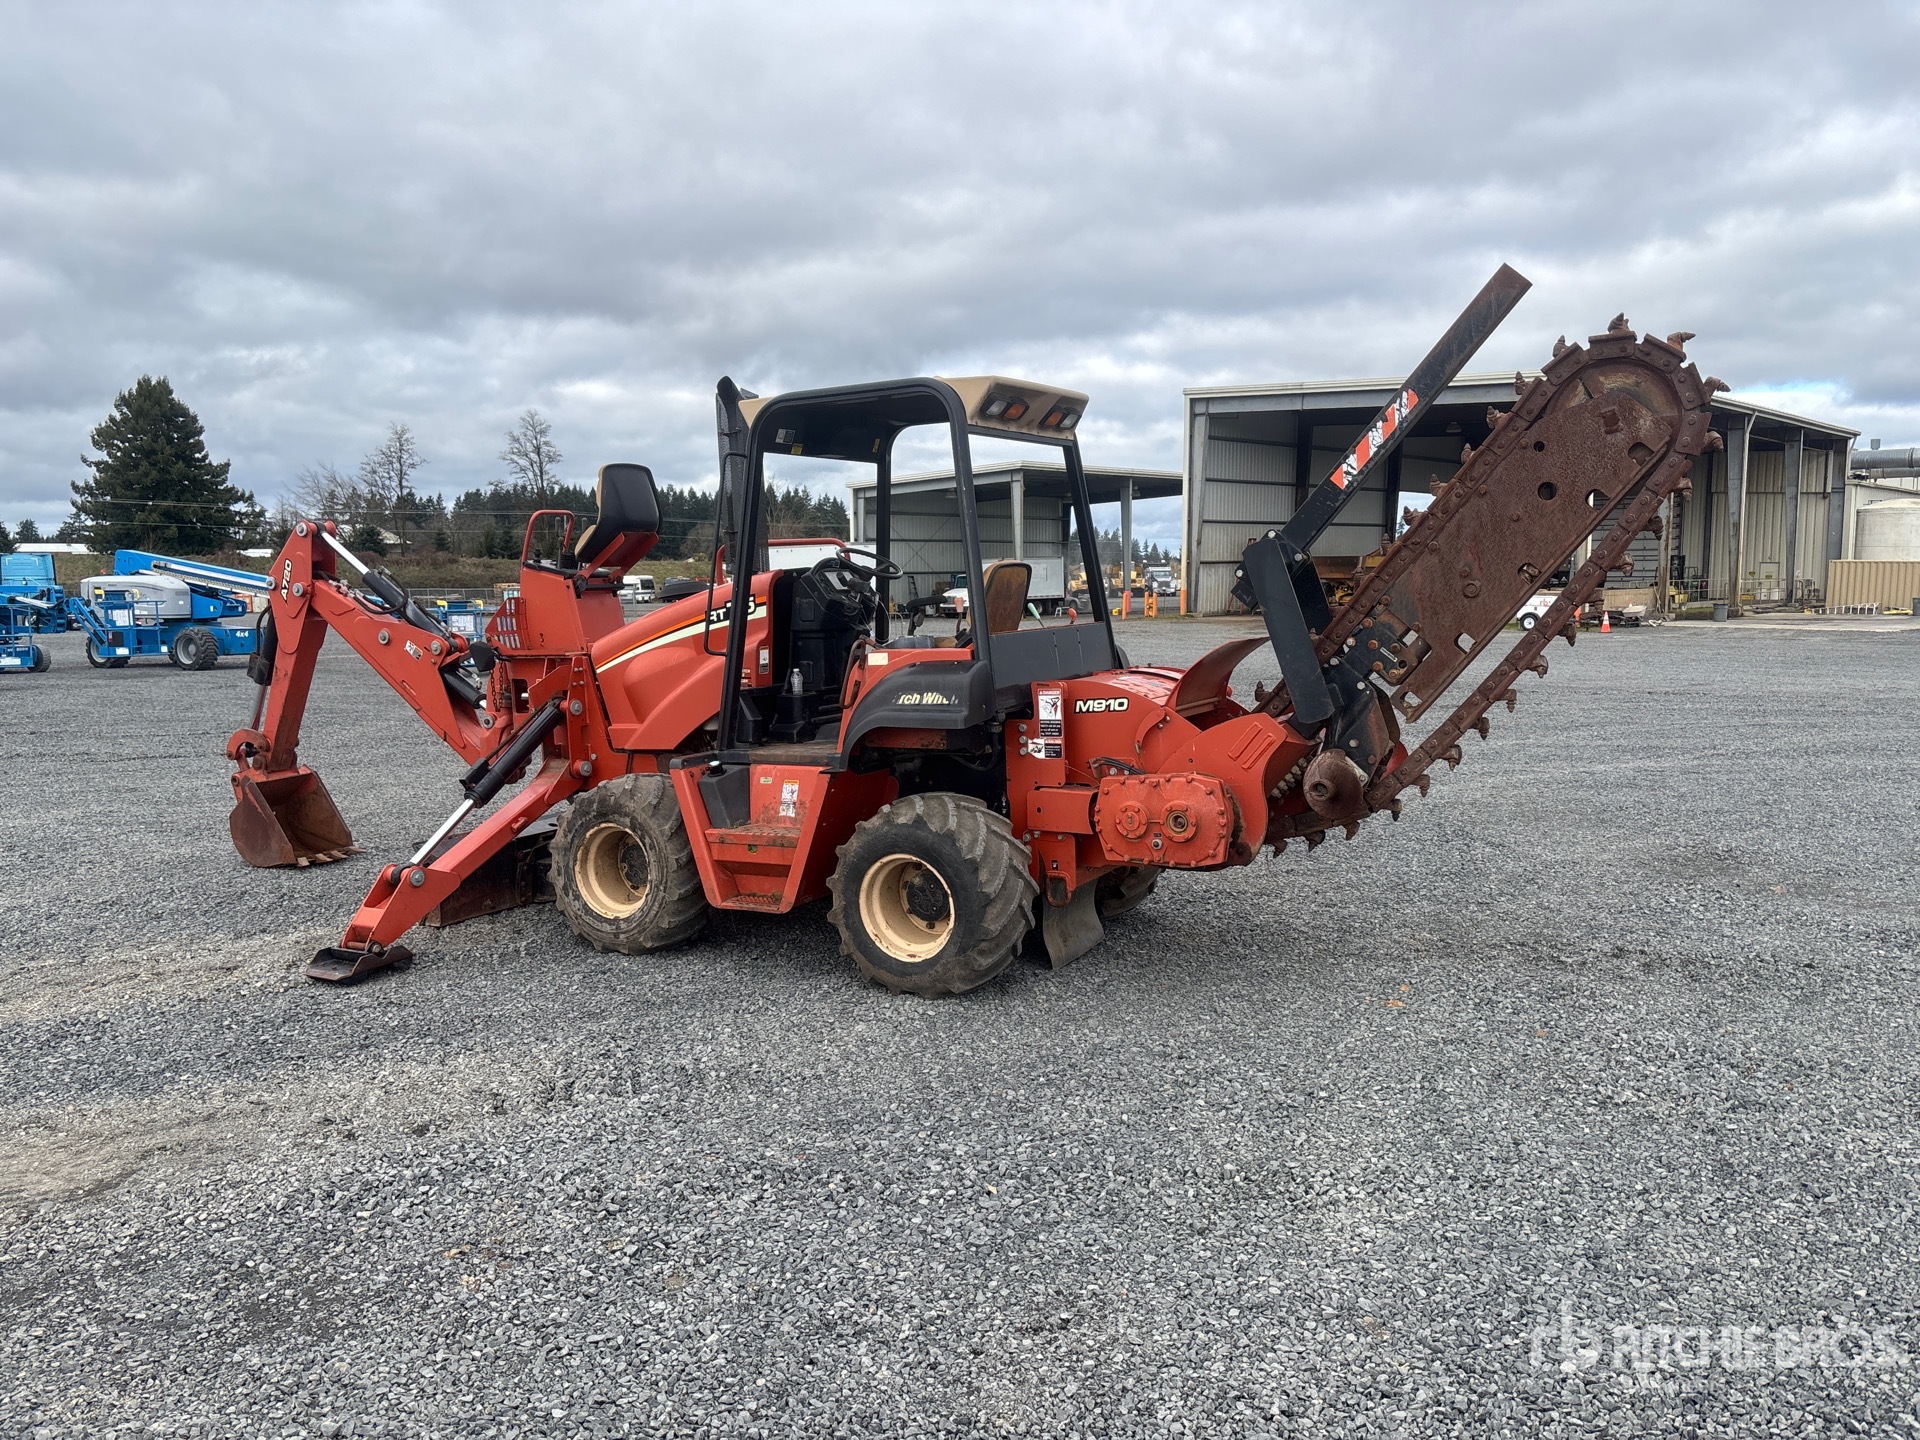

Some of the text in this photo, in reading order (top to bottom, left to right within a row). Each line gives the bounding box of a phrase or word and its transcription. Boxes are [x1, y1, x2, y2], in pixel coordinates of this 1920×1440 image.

[281, 559, 293, 601] A720
[709, 596, 755, 621] RT5
[235, 630, 249, 638] 4x4
[1075, 697, 1129, 713] M910
